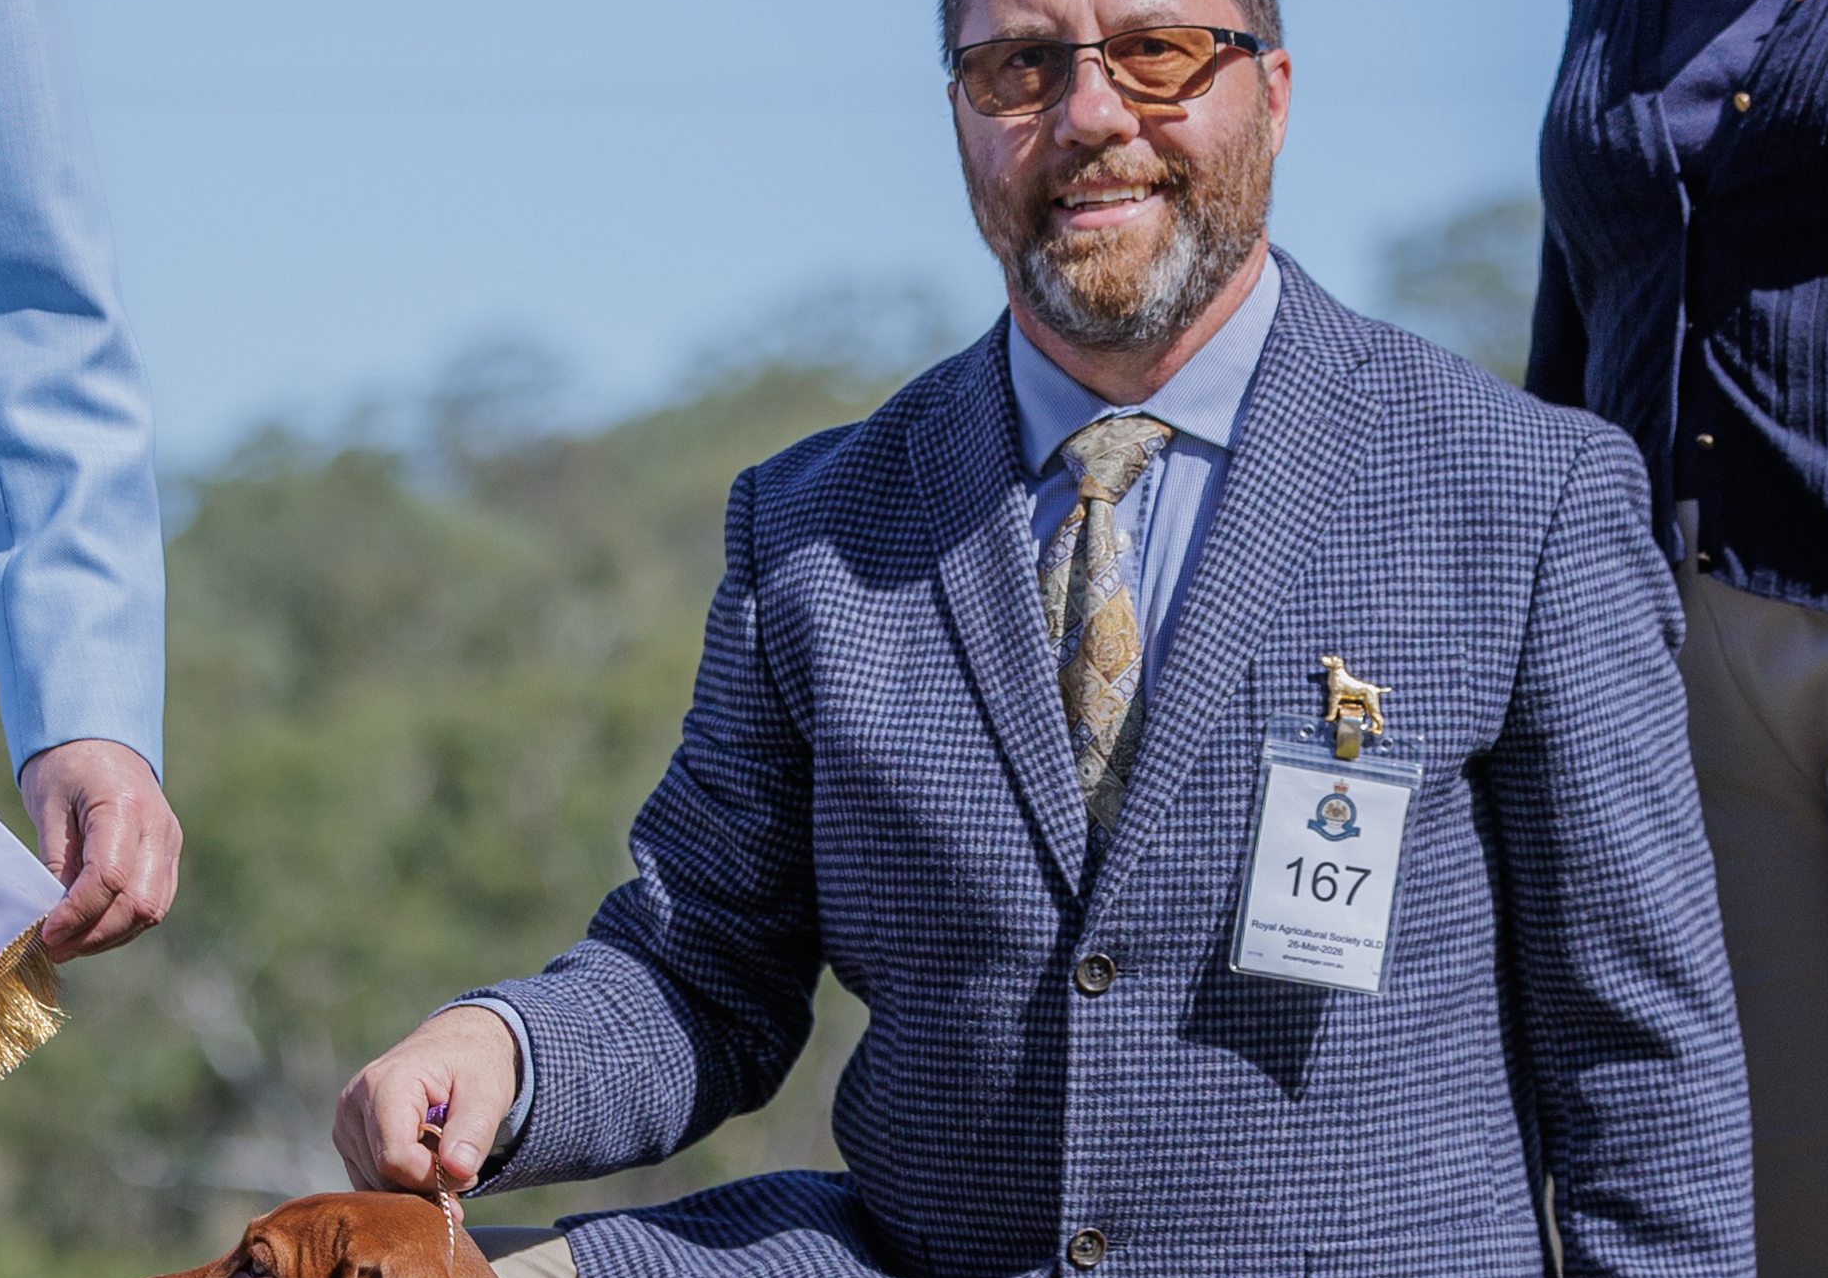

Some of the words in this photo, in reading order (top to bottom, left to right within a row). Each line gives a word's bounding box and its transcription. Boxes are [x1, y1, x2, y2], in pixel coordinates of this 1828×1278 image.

[1286, 856, 1372, 906] 167
[1251, 919, 1277, 932] Royal
[1278, 924, 1327, 940] Agricultural
[1329, 932, 1361, 947] Society
[1363, 938, 1384, 949] QLD
[1287, 939, 1344, 956] 26-Mar-2026
